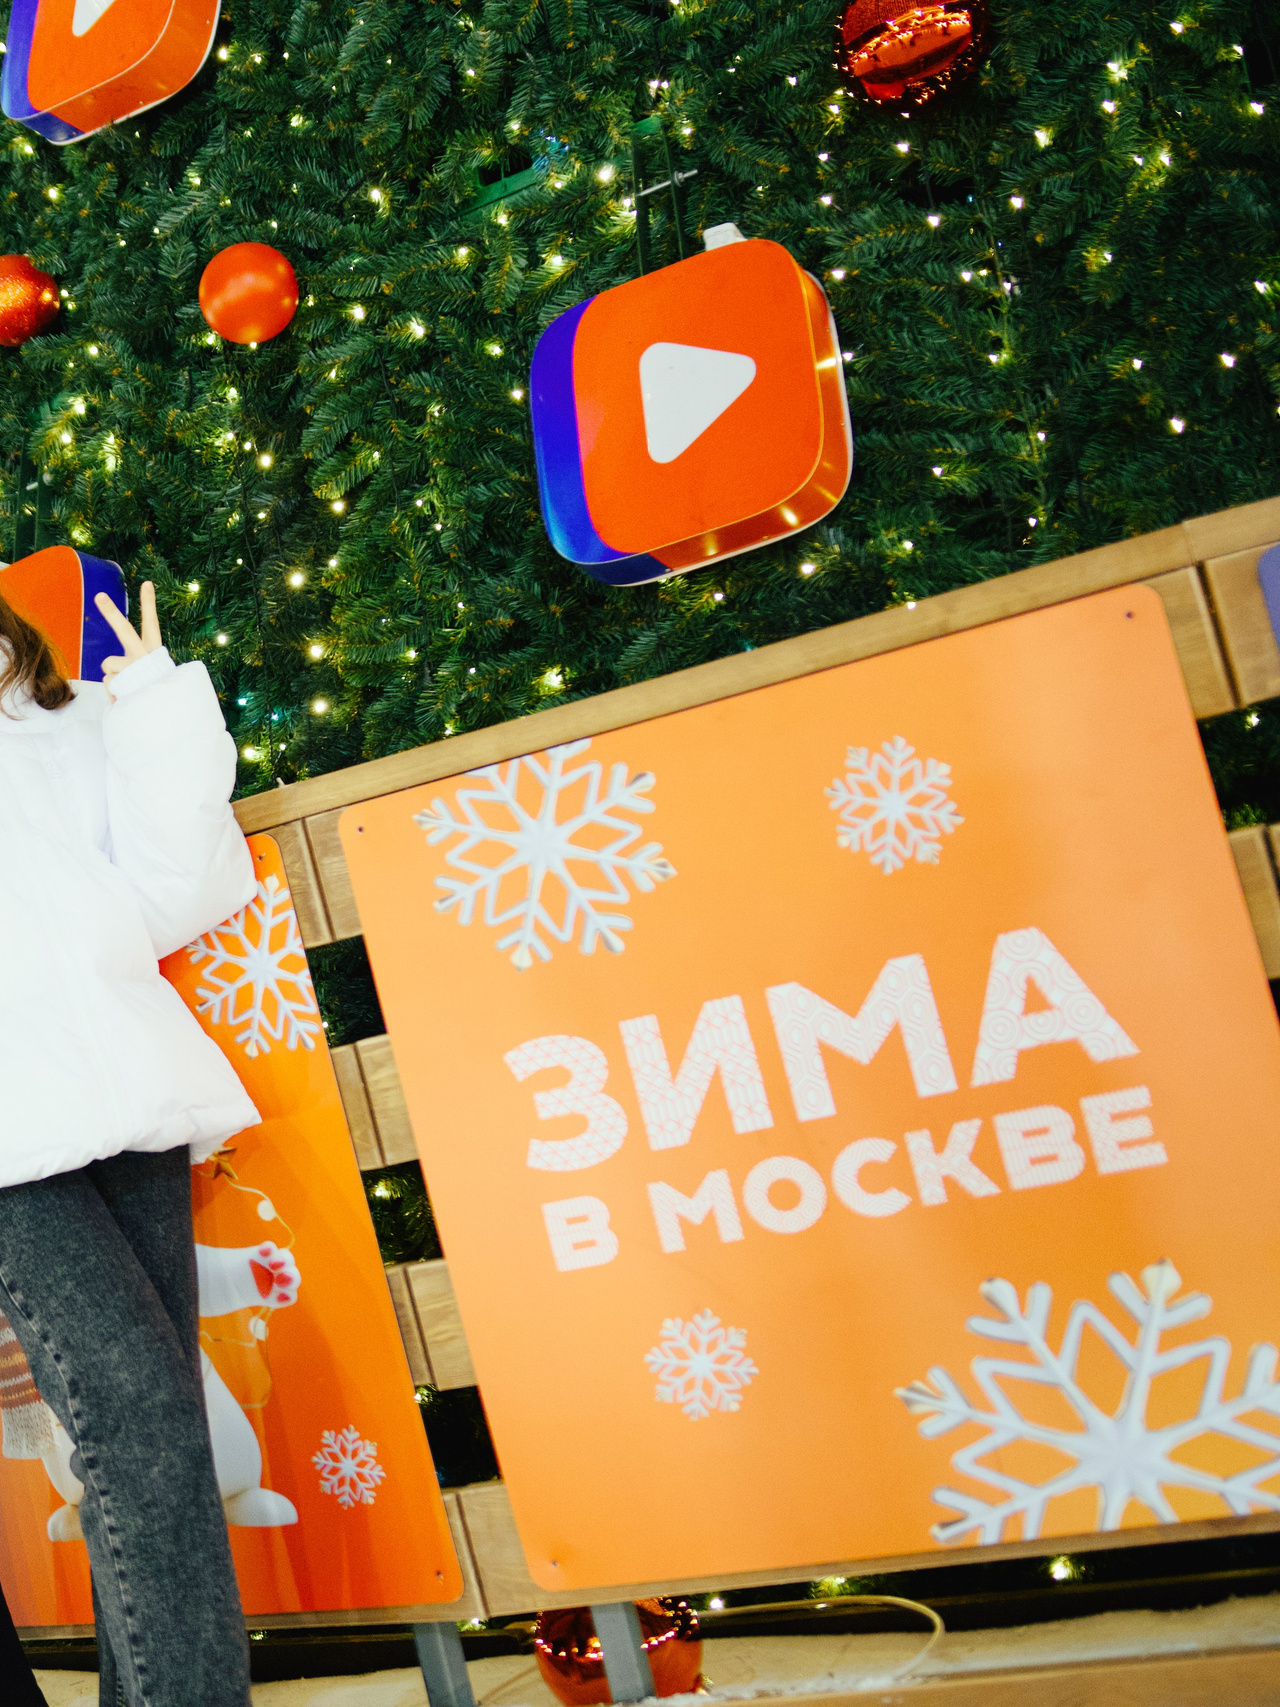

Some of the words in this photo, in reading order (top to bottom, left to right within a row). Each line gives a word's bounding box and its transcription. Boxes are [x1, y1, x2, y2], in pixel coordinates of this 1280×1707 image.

[503, 926, 1141, 1173] ЗИМА
[541, 1195, 620, 1273] В
[647, 1085, 1169, 1254] МОСКВЕ
